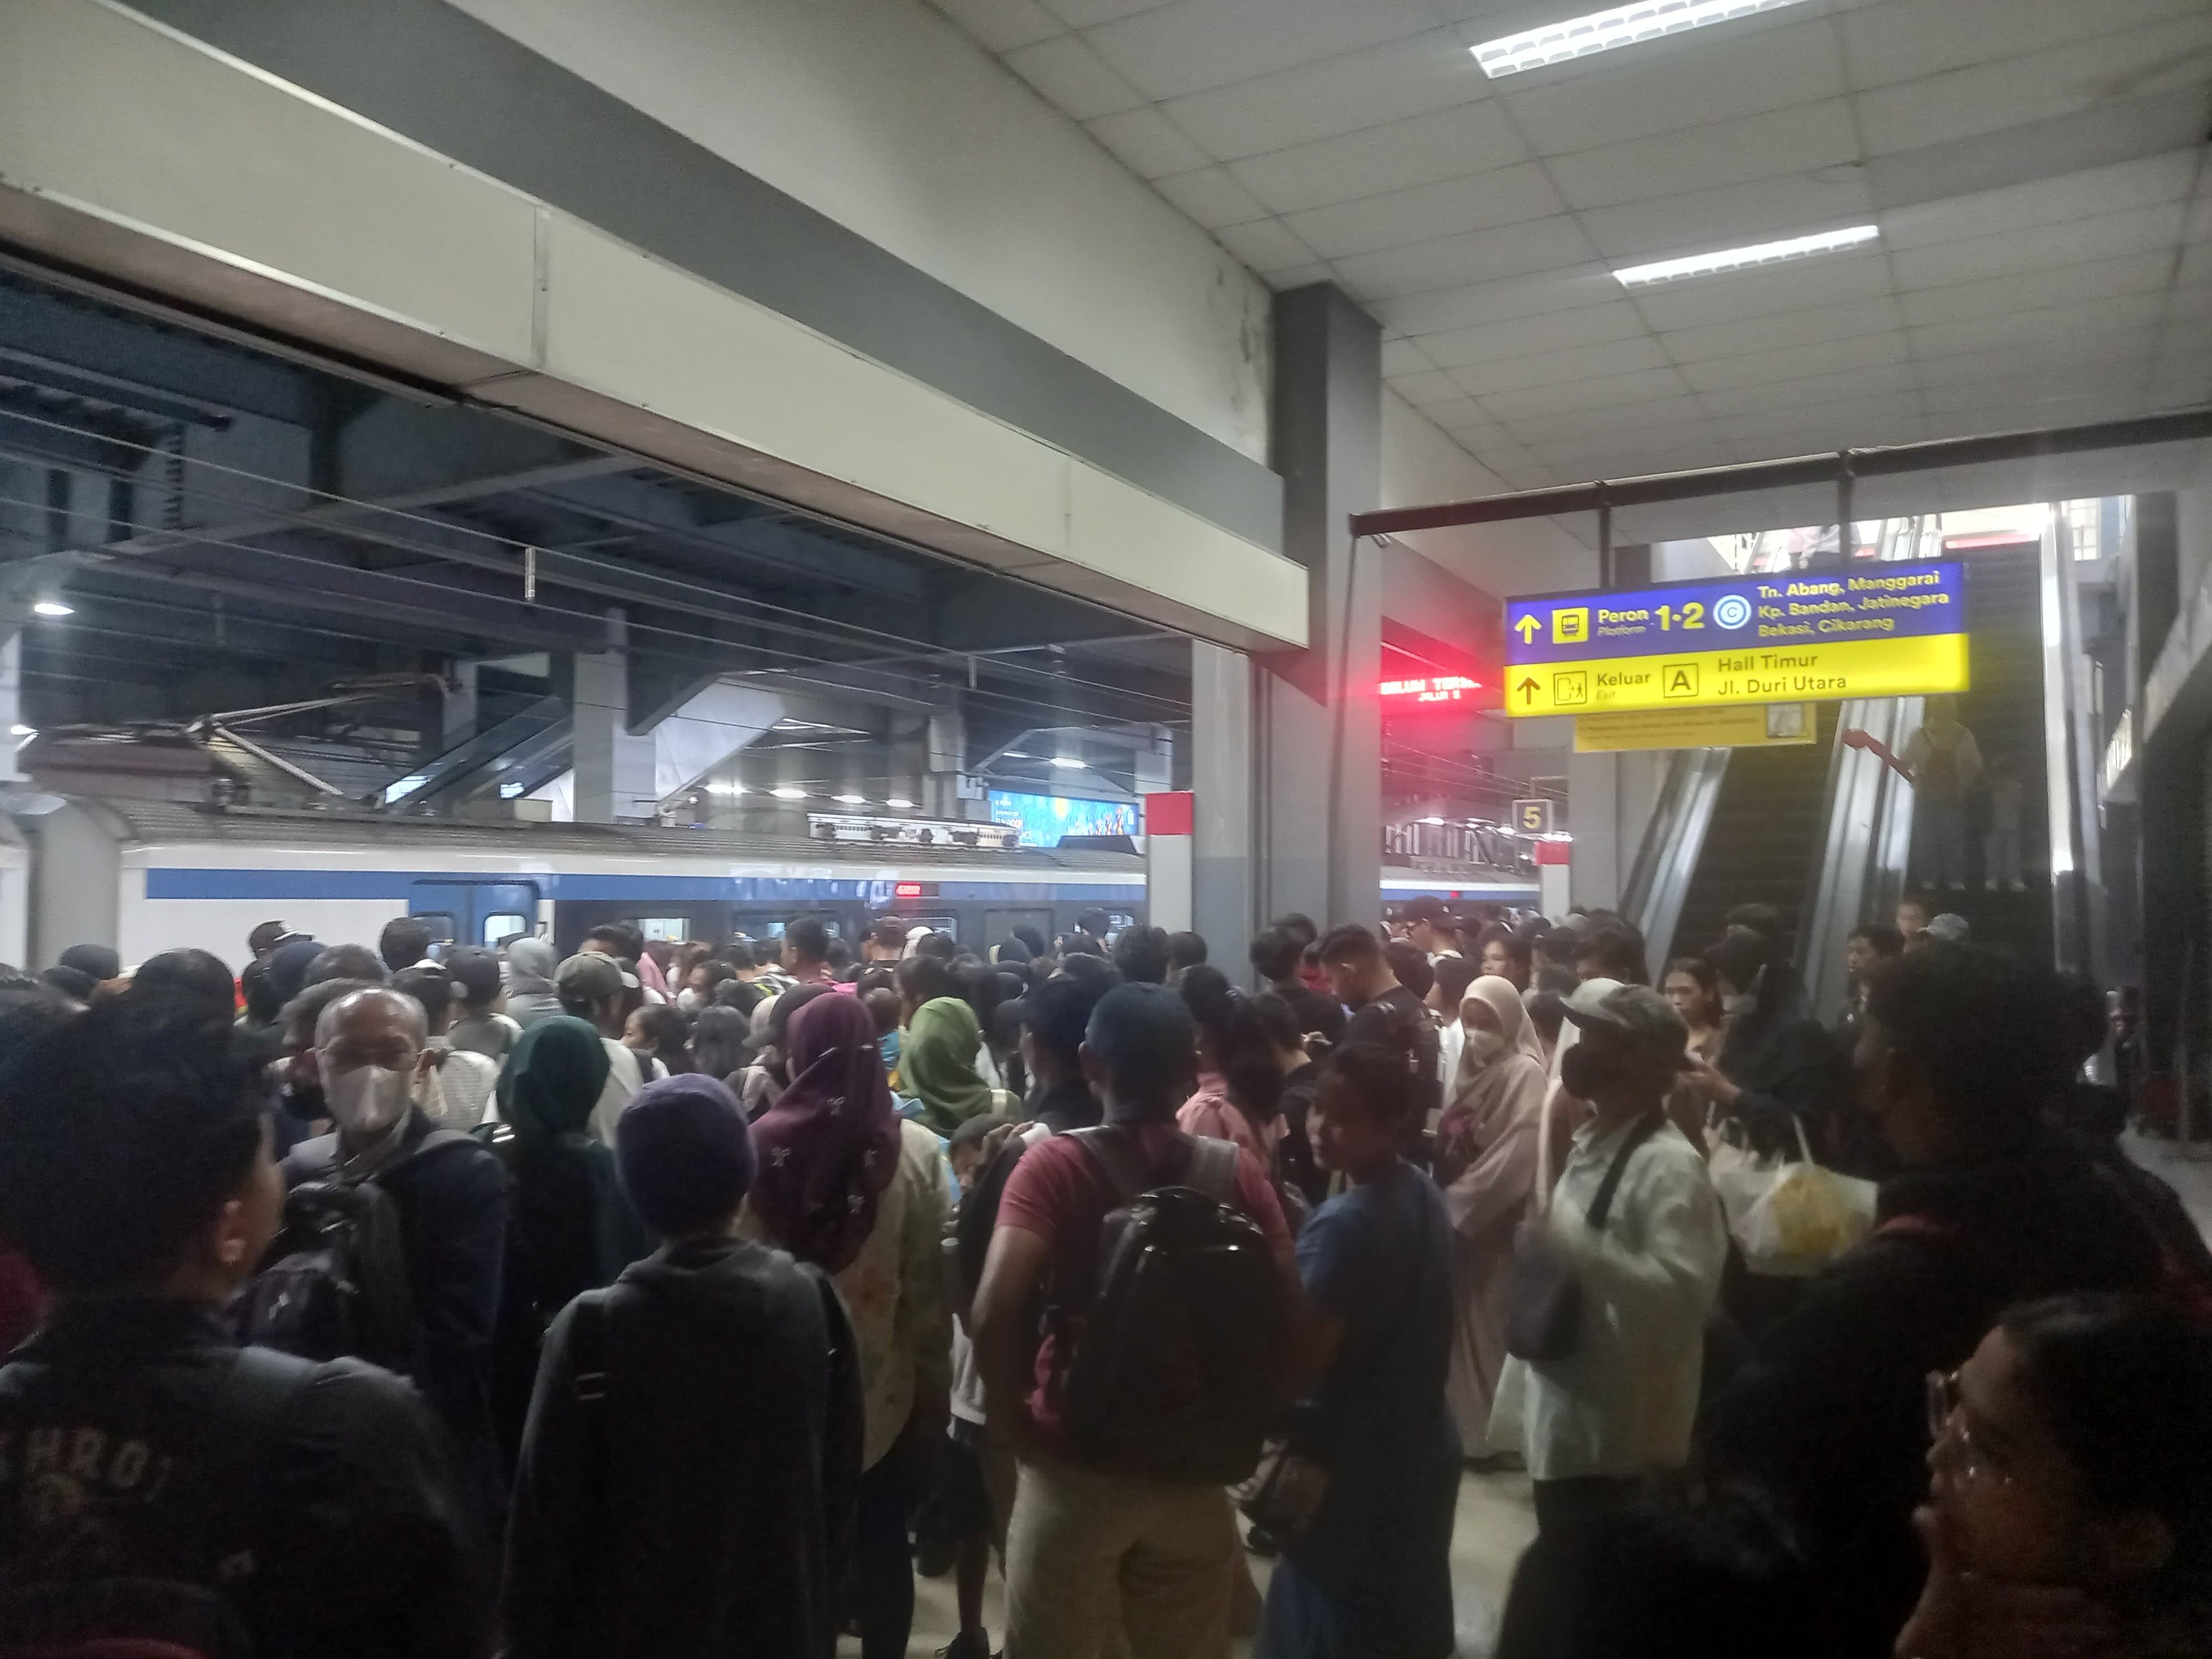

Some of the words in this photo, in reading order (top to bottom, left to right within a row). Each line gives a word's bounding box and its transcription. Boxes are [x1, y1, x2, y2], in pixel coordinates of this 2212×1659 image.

[1757, 586, 1784, 599] Tn.
[1786, 581, 1845, 597] Abang,
[1848, 570, 1940, 592] Manggarai
[1857, 591, 1950, 611] Jatinegara
[1597, 609, 1650, 623] Peron
[1727, 607, 1738, 618] C
[1758, 620, 1815, 637] Bekasi,
[1817, 617, 1895, 634] Cikarang
[1718, 655, 1755, 672] Hall
[1761, 654, 1818, 669] Timur
[1597, 672, 1651, 686] Keluar
[1670, 670, 1692, 691] A
[1718, 681, 1740, 696] Jl.
[1747, 677, 1787, 693] Duri
[1794, 675, 1847, 691] Utara
[1596, 690, 1616, 700] Exit
[1522, 806, 1541, 830] 5
